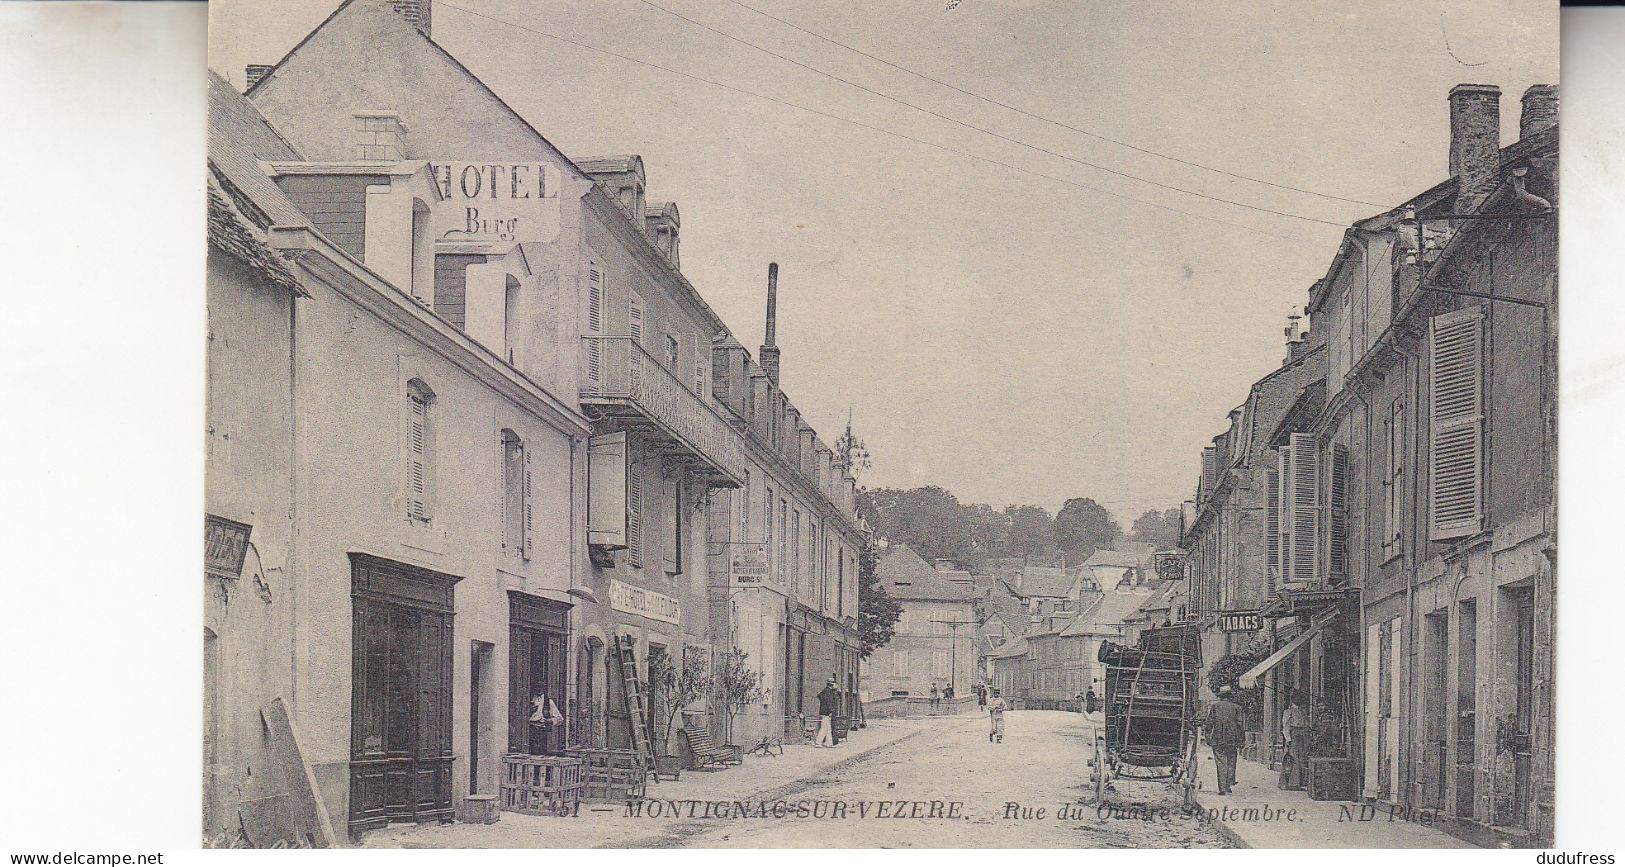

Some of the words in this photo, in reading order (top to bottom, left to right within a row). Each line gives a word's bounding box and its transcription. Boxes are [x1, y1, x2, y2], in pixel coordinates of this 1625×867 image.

[432, 164, 558, 199] HOTEL
[444, 207, 518, 241] Burg
[1221, 615, 1258, 631] TABACS
